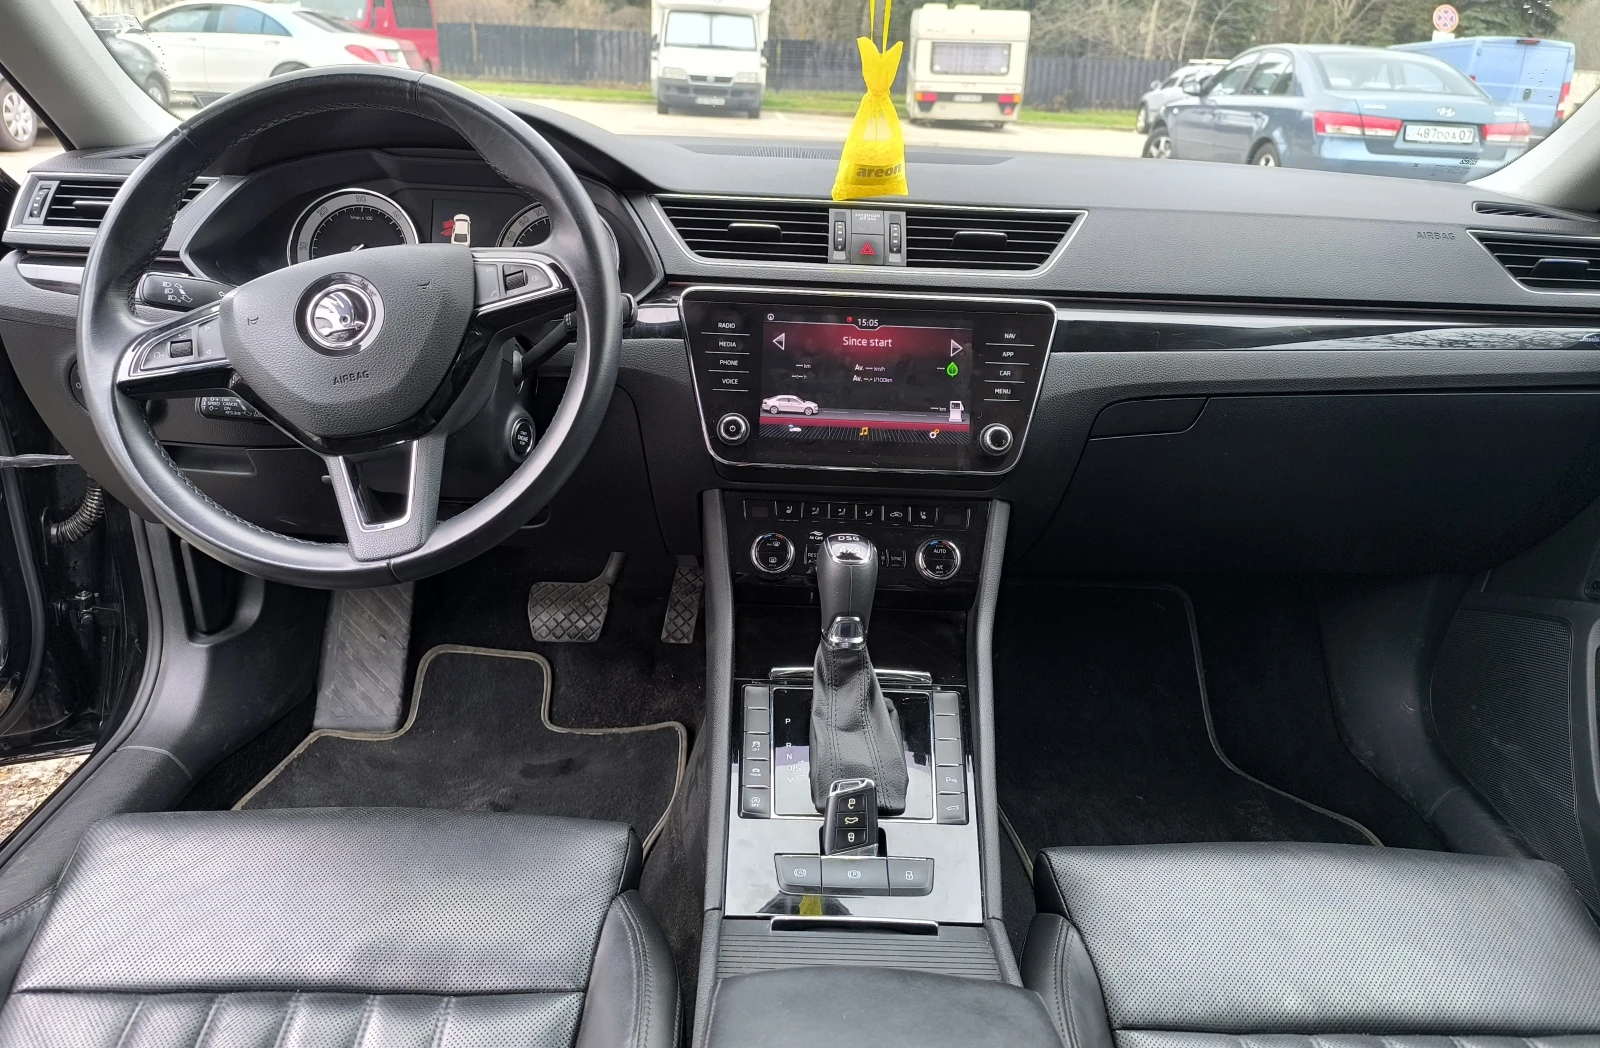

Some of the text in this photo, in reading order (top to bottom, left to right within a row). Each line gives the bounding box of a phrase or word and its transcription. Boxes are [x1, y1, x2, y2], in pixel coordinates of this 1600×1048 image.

[856, 164, 901, 177] areon
[1416, 231, 1455, 240] AIRBAG
[858, 318, 879, 327] 15:05
[842, 336, 893, 347] Since start
[333, 370, 370, 386] AIRBAG
